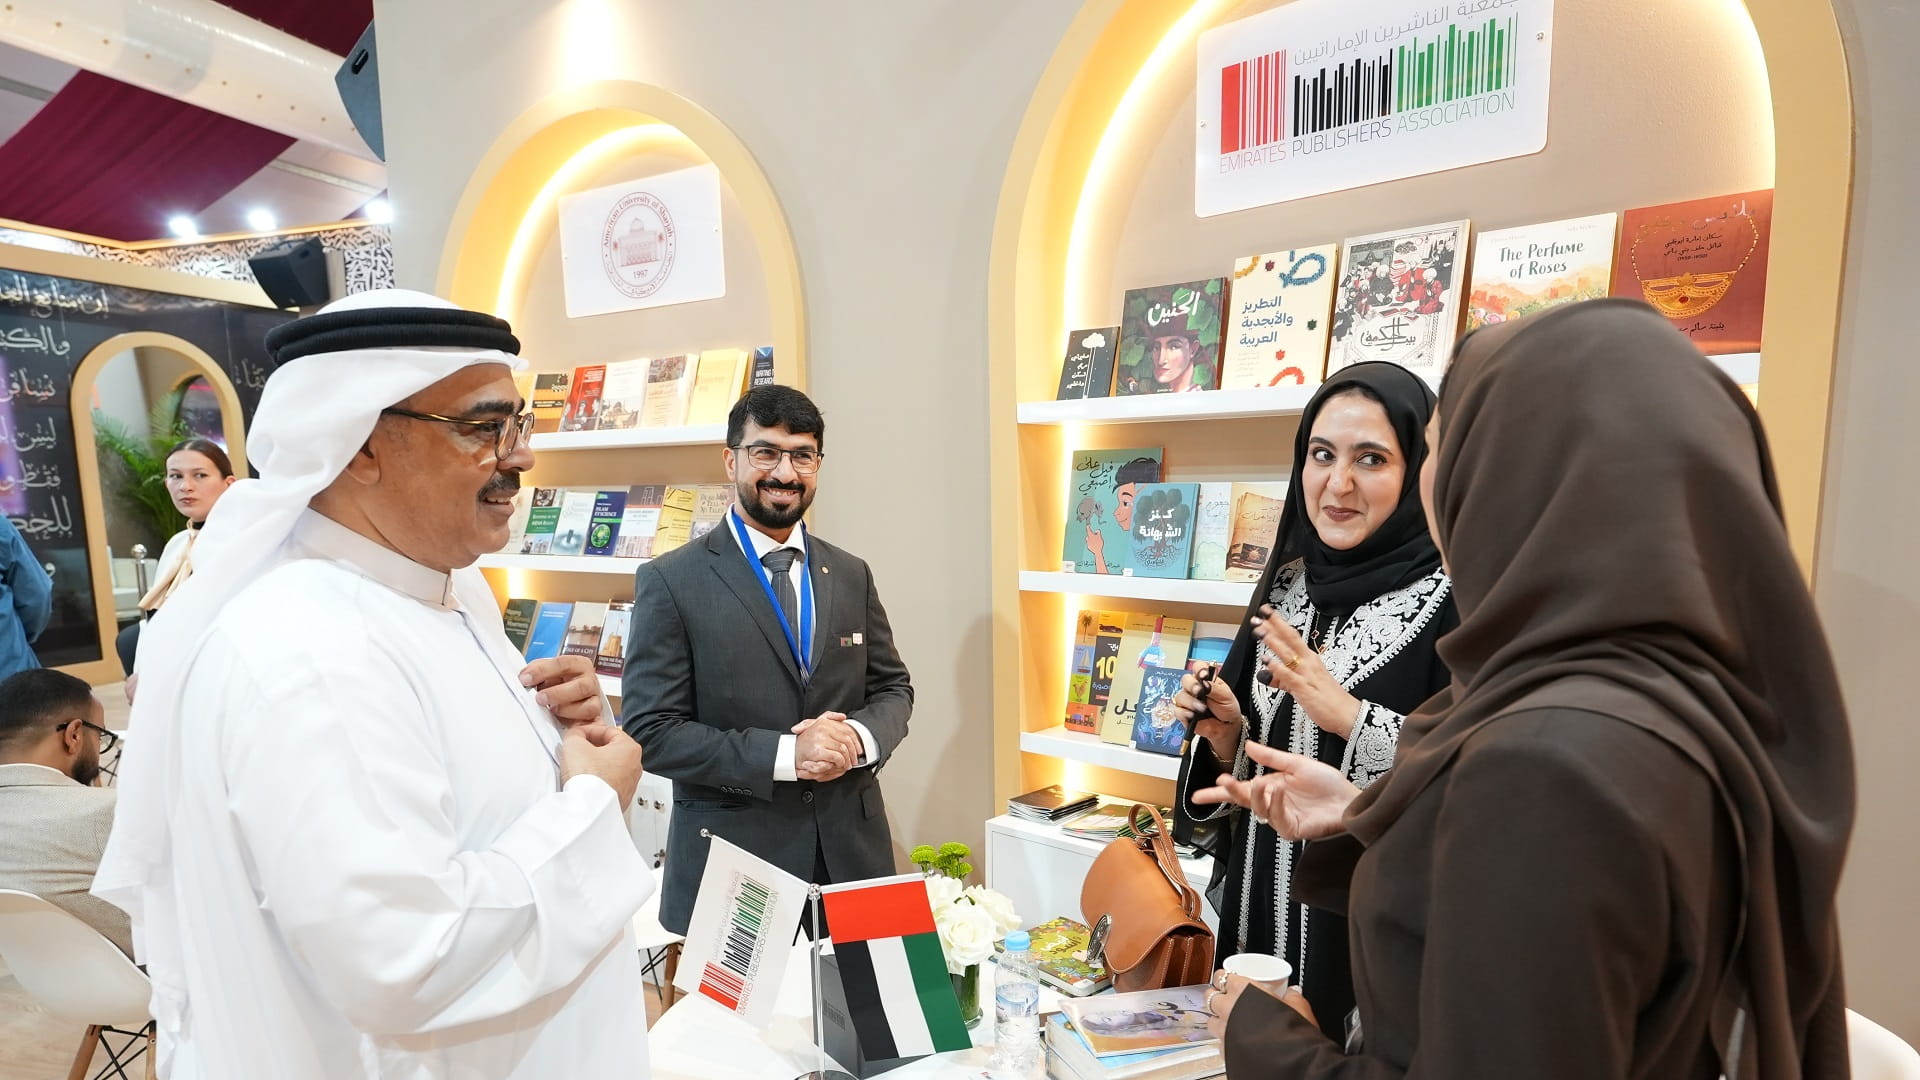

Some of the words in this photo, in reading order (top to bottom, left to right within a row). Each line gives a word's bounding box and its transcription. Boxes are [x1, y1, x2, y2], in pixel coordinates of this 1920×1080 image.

[1374, 6, 1450, 43] الناشرين
[1293, 29, 1369, 66] الإماراتيين
[1219, 144, 1288, 174] EMIRATES
[1292, 118, 1393, 157] PUBLISHERS
[1396, 90, 1517, 135] ASSOCIATION
[604, 209, 620, 248] American
[659, 206, 673, 238] Sharjah
[1499, 246, 1523, 263] The
[1527, 241, 1585, 259] Perfume
[1509, 263, 1524, 280] of
[1528, 260, 1568, 276] Roses
[1147, 290, 1201, 327] الحنين
[1241, 295, 1282, 314] التطريز
[1241, 310, 1294, 329] والأبجدية
[1239, 331, 1278, 348] العربية
[747, 937, 766, 982] PUBLISHERS
[761, 889, 779, 937] ASSOCIATION
